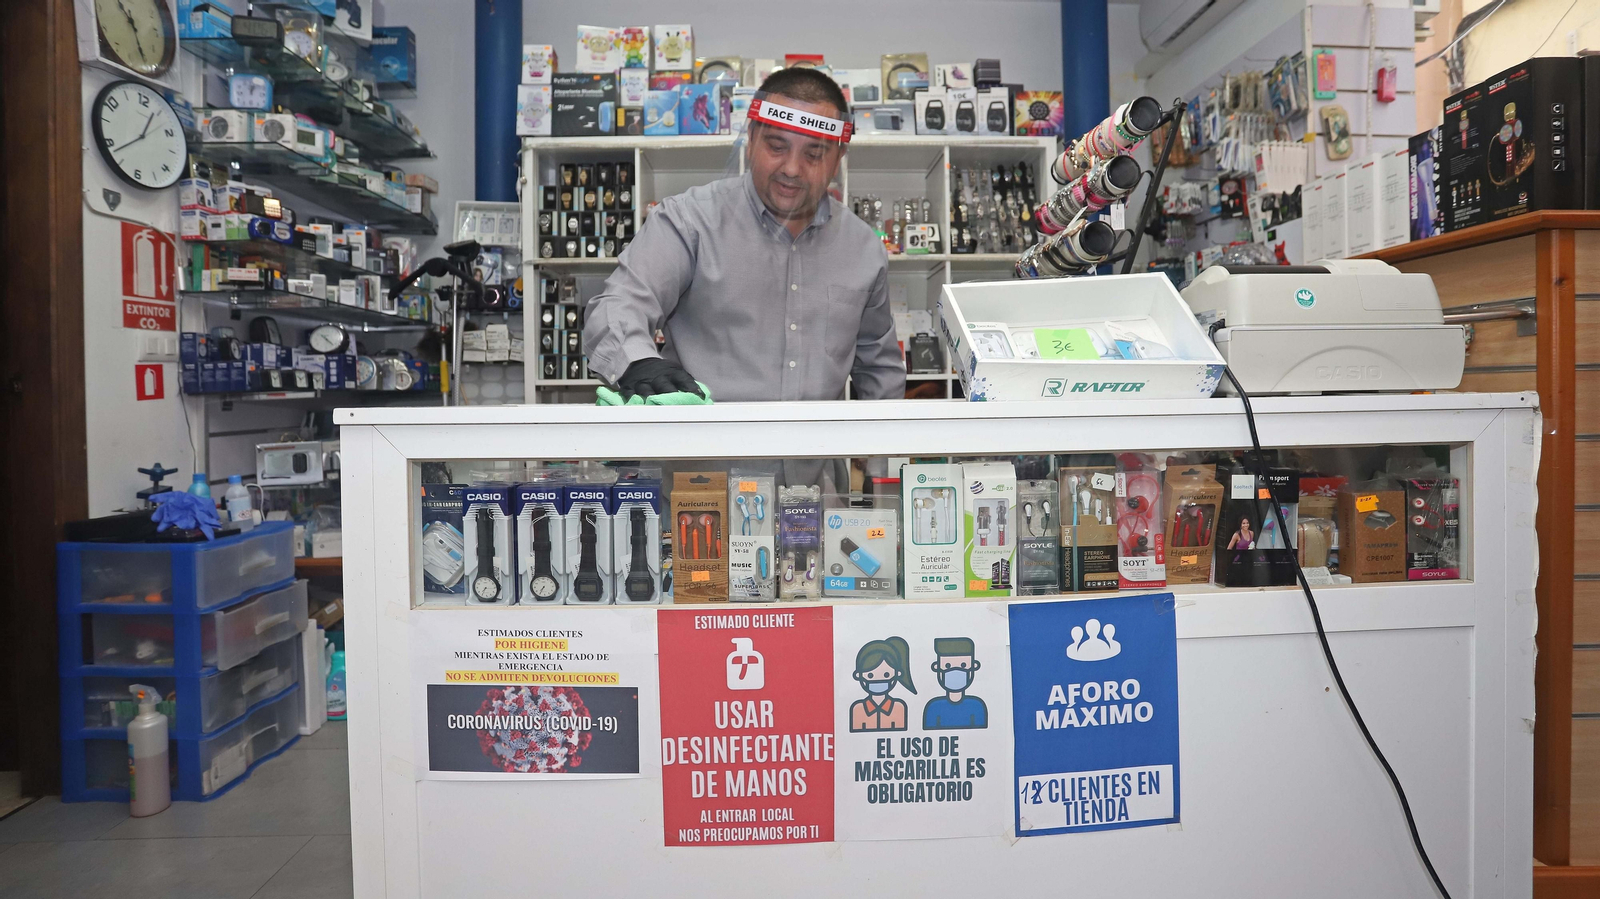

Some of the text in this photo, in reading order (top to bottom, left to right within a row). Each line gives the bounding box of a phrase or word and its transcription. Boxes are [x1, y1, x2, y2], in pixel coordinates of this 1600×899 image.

[104, 96, 119, 112] 10
[138, 92, 150, 108] 12
[767, 107, 837, 132] FACE SHIELD
[134, 169, 142, 180] 6
[1410, 154, 1418, 193] KARAOKE
[126, 303, 170, 318] EXTINTOR
[1315, 365, 1383, 380] CASIO
[1070, 381, 1146, 393] RAPTOR
[466, 493, 501, 501] CASIO
[521, 492, 556, 500] CASIO
[569, 491, 605, 499] CASIO
[617, 491, 653, 499] CASIO
[844, 519, 871, 527] USB 2.0
[1064, 528, 1072, 546] In-Ear
[920, 555, 951, 563] Estéreo
[1170, 549, 1208, 557] Headset
[1366, 554, 1394, 562] CPE1007
[679, 562, 721, 571] Headset
[684, 582, 701, 590] FOR
[830, 579, 848, 587] 64GB
[694, 613, 795, 630] ESTIMADO CLIENTE
[477, 629, 584, 638] ESTIMADOS CLIENTES
[494, 639, 566, 650] POR HIGIENE
[454, 650, 610, 661] MIENTRAS EXISTA EL ESTADO DE
[498, 662, 564, 672] EMERGENCIA
[445, 672, 617, 683] NO SE ADMITEN DEVOLUCIONES
[1047, 678, 1141, 706] AFORO
[714, 699, 774, 729] USAR
[1035, 699, 1154, 730] MÁXIMO
[447, 714, 619, 733] CORONAVIRUS (COVID-19)
[662, 733, 834, 766] DESINFECTANTE
[876, 735, 959, 759] EL USO DE
[854, 757, 986, 782] MASCARILLA ES
[691, 767, 807, 798] DE MANOS
[1048, 775, 1132, 802] CLIENTES
[1138, 770, 1160, 795] EN
[867, 781, 973, 804] OBLIGATORIO
[700, 807, 795, 823] AL ENTRAR LOCAL
[1064, 798, 1129, 825] TIENDA
[679, 824, 819, 842] NOS PREOCUPAMOS POR TI
